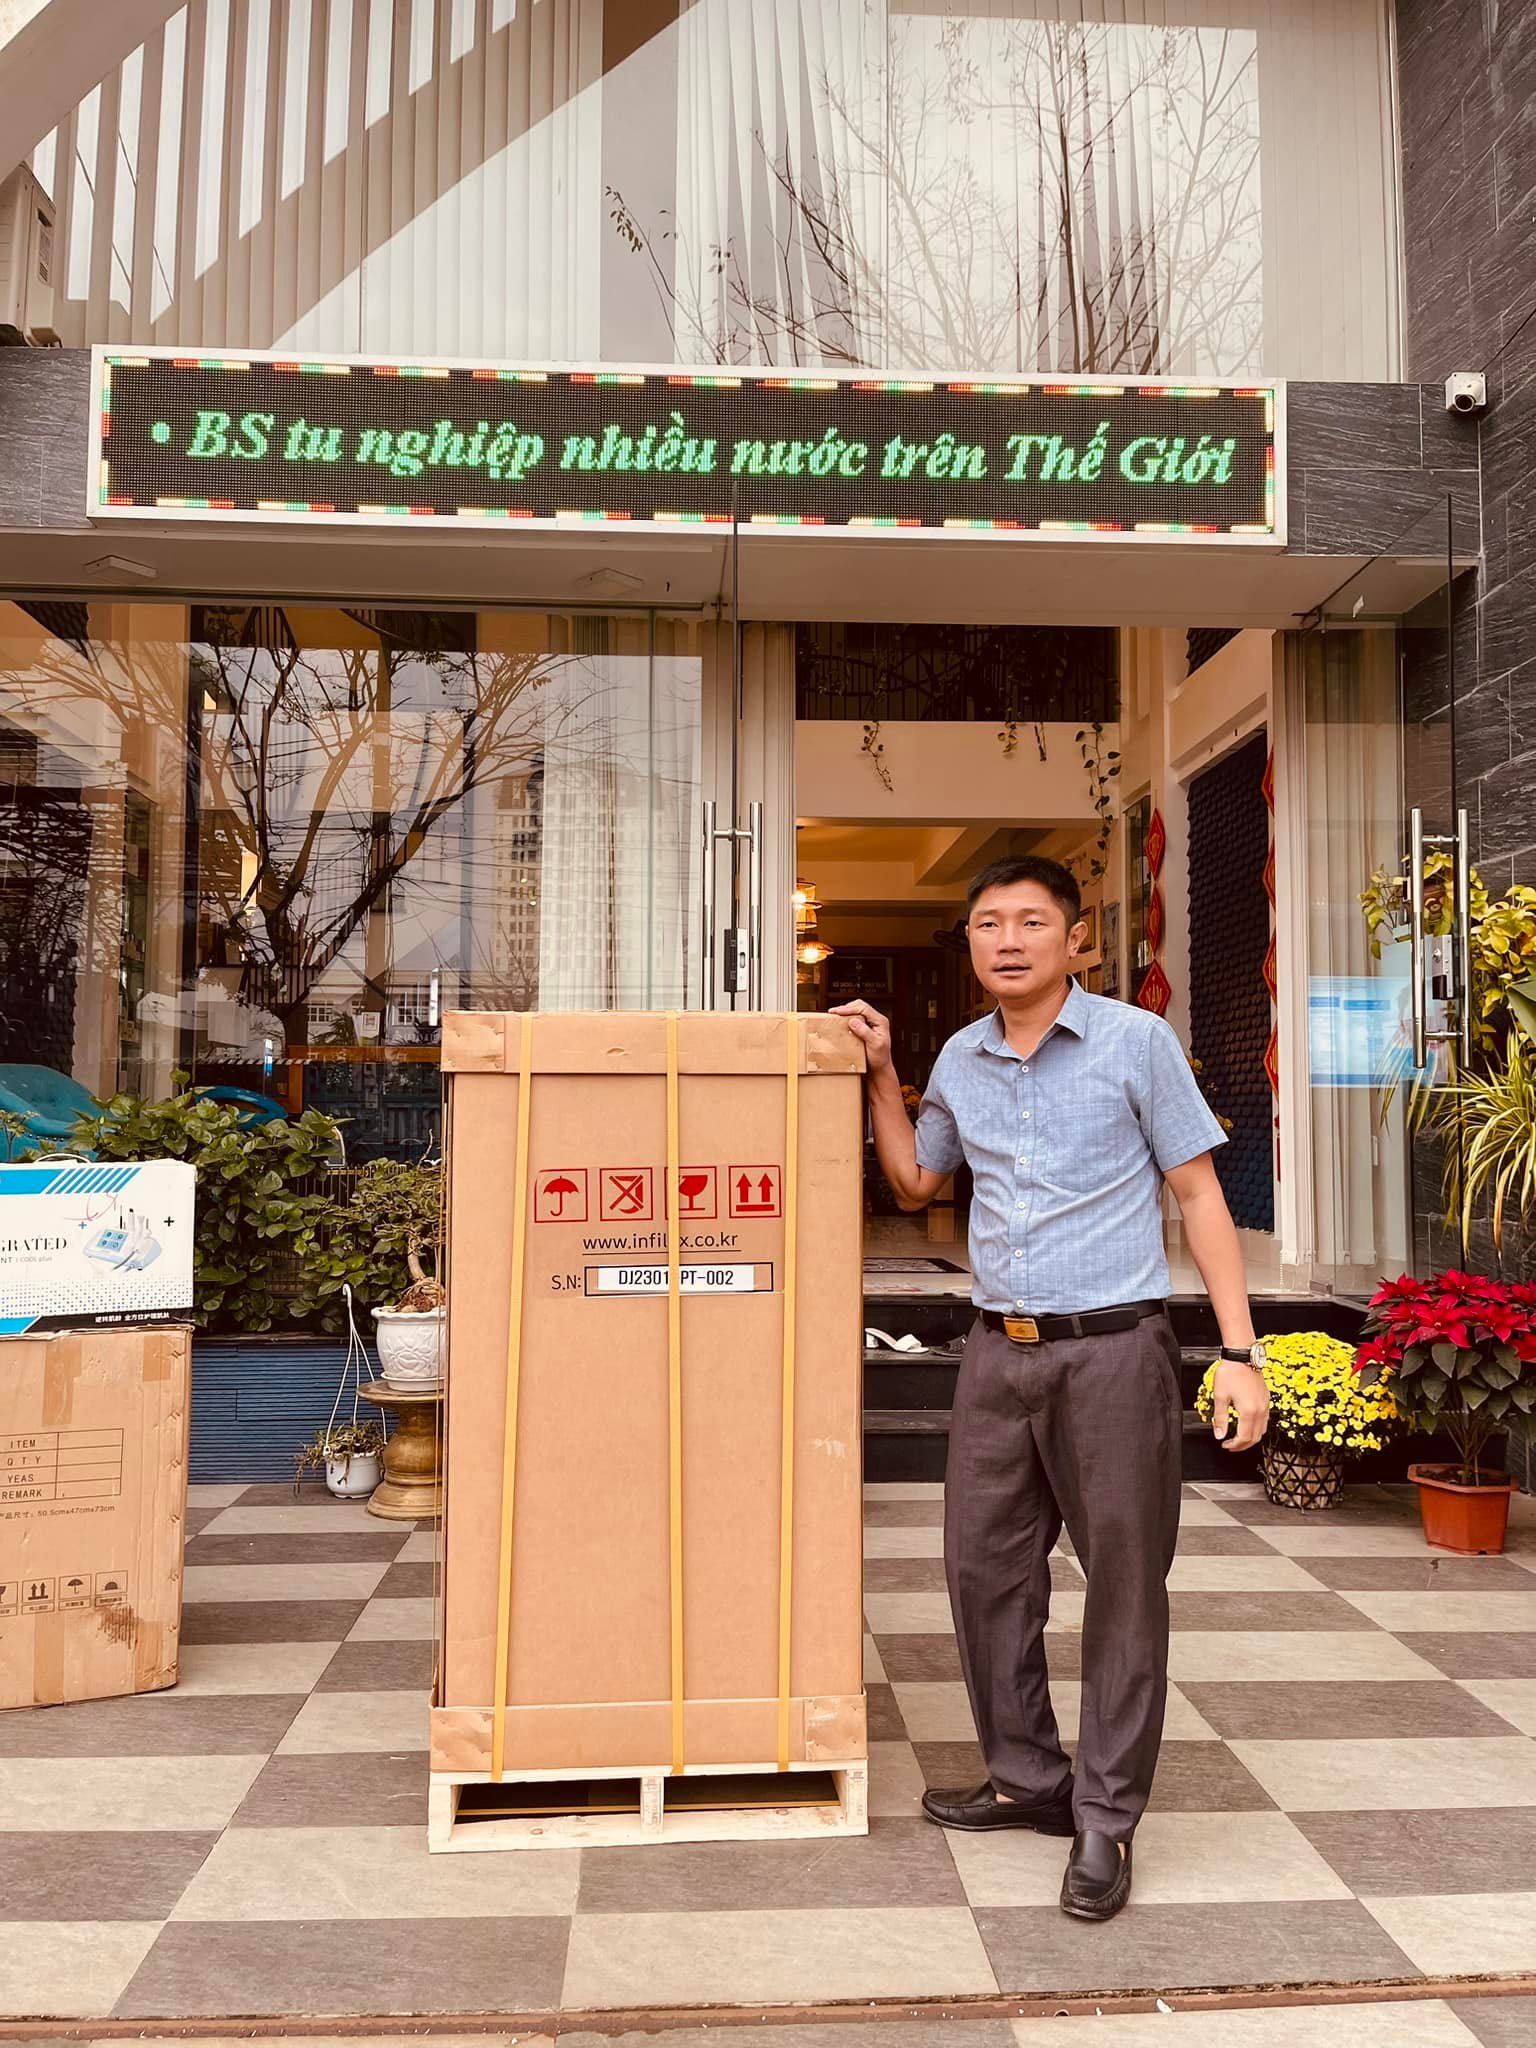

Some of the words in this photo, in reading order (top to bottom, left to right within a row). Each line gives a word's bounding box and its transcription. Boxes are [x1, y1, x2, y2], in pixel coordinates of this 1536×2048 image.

[356, 419, 545, 480] nghiệp
[559, 410, 717, 473] nhiều
[730, 426, 869, 477] nước
[880, 432, 988, 480] trên
[1003, 420, 1111, 481] Thế
[1119, 434, 1236, 484] Giới
[583, 1232, 738, 1250] www.infilx.co.kr
[551, 1273, 582, 1291] S.N:
[618, 1269, 734, 1286] DJ2301PT-002
[10, 1439, 36, 1449] ITEM
[8, 1473, 34, 1484] YEAS
[1, 1488, 42, 1500] REMARK
